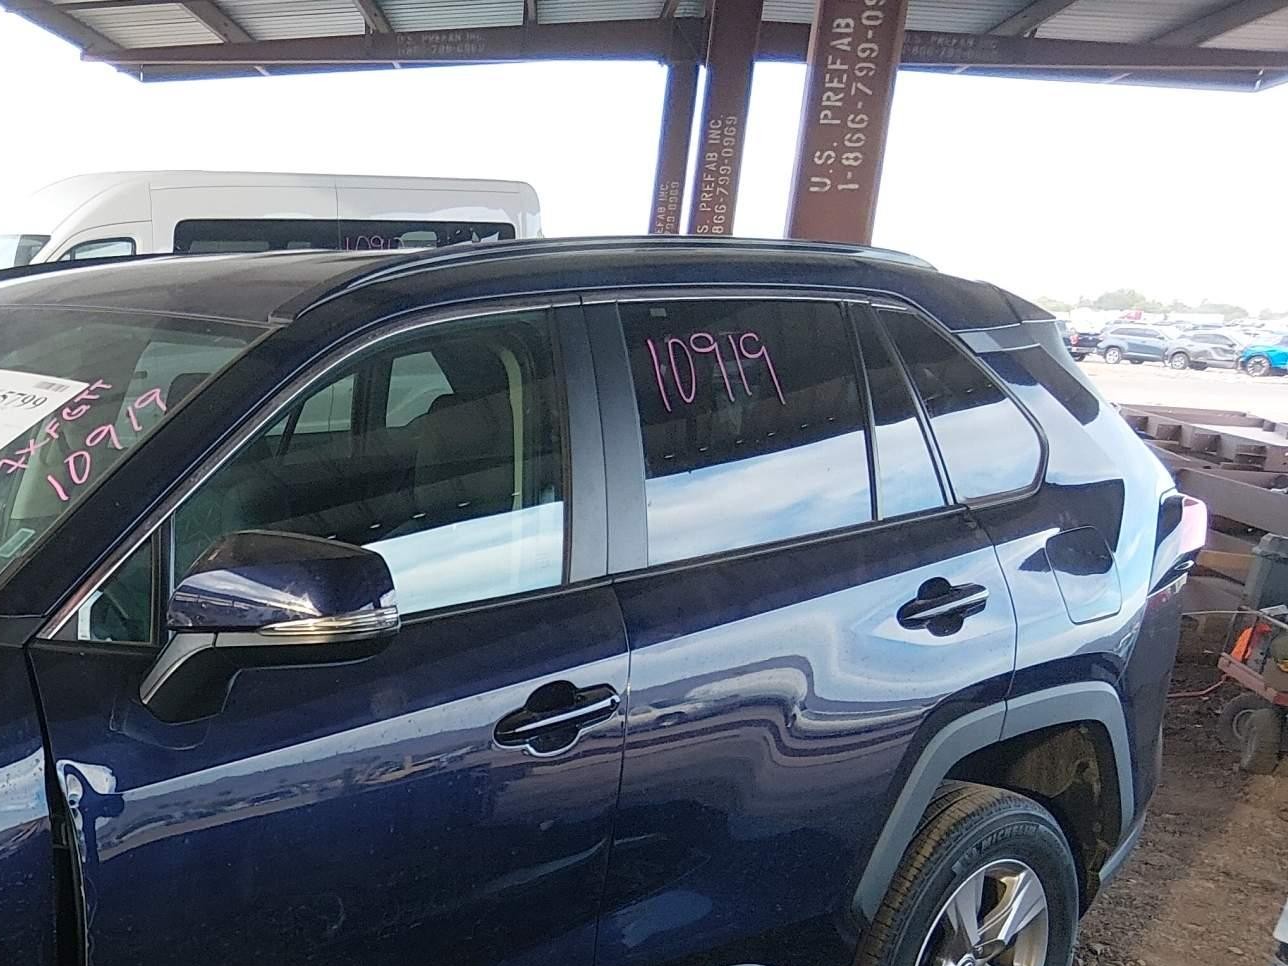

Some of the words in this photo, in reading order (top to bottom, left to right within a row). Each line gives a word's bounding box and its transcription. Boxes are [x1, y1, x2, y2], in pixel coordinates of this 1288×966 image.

[819, 17, 856, 125] PREFAB
[708, 114, 724, 144] INC.
[699, 152, 718, 211] PREFAB
[809, 142, 838, 192] U.S.
[647, 332, 787, 413] 10919
[47, 388, 167, 501] 10919
